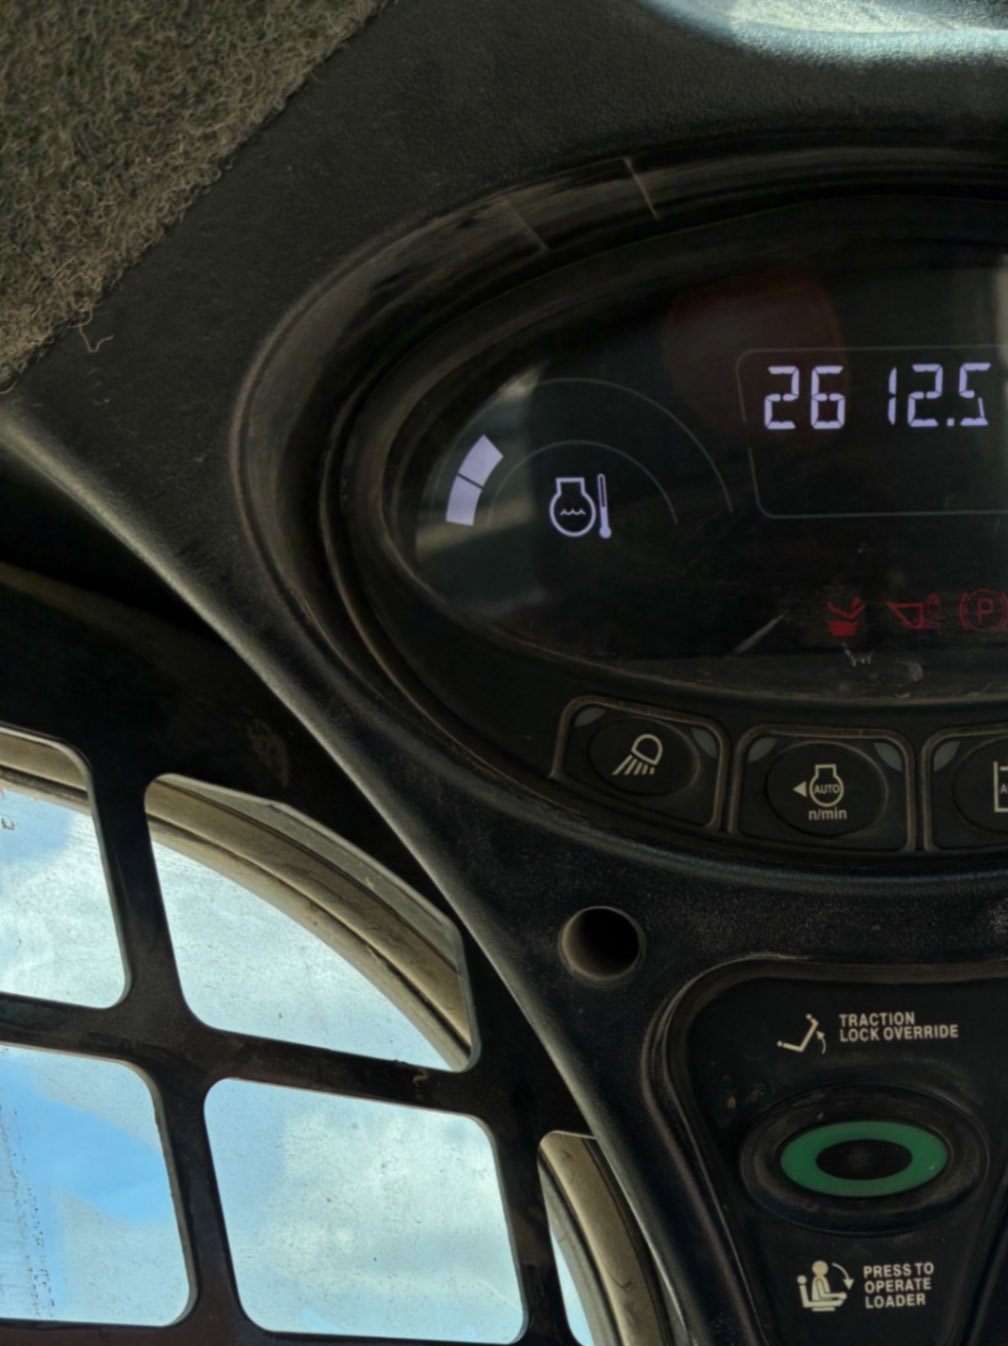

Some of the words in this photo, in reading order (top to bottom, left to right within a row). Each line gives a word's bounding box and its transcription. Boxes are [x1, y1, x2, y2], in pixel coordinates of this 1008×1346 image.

[814, 783, 840, 794] AUTO
[808, 807, 848, 821] n/min
[839, 1011, 915, 1027] TRACTION
[840, 1027, 880, 1042] LOCK
[883, 1024, 959, 1041] OVERRIDE
[863, 1263, 912, 1278] PRESS
[915, 1262, 935, 1275] TO
[864, 1277, 932, 1294] OPERATE
[865, 1293, 926, 1309] LOADER
